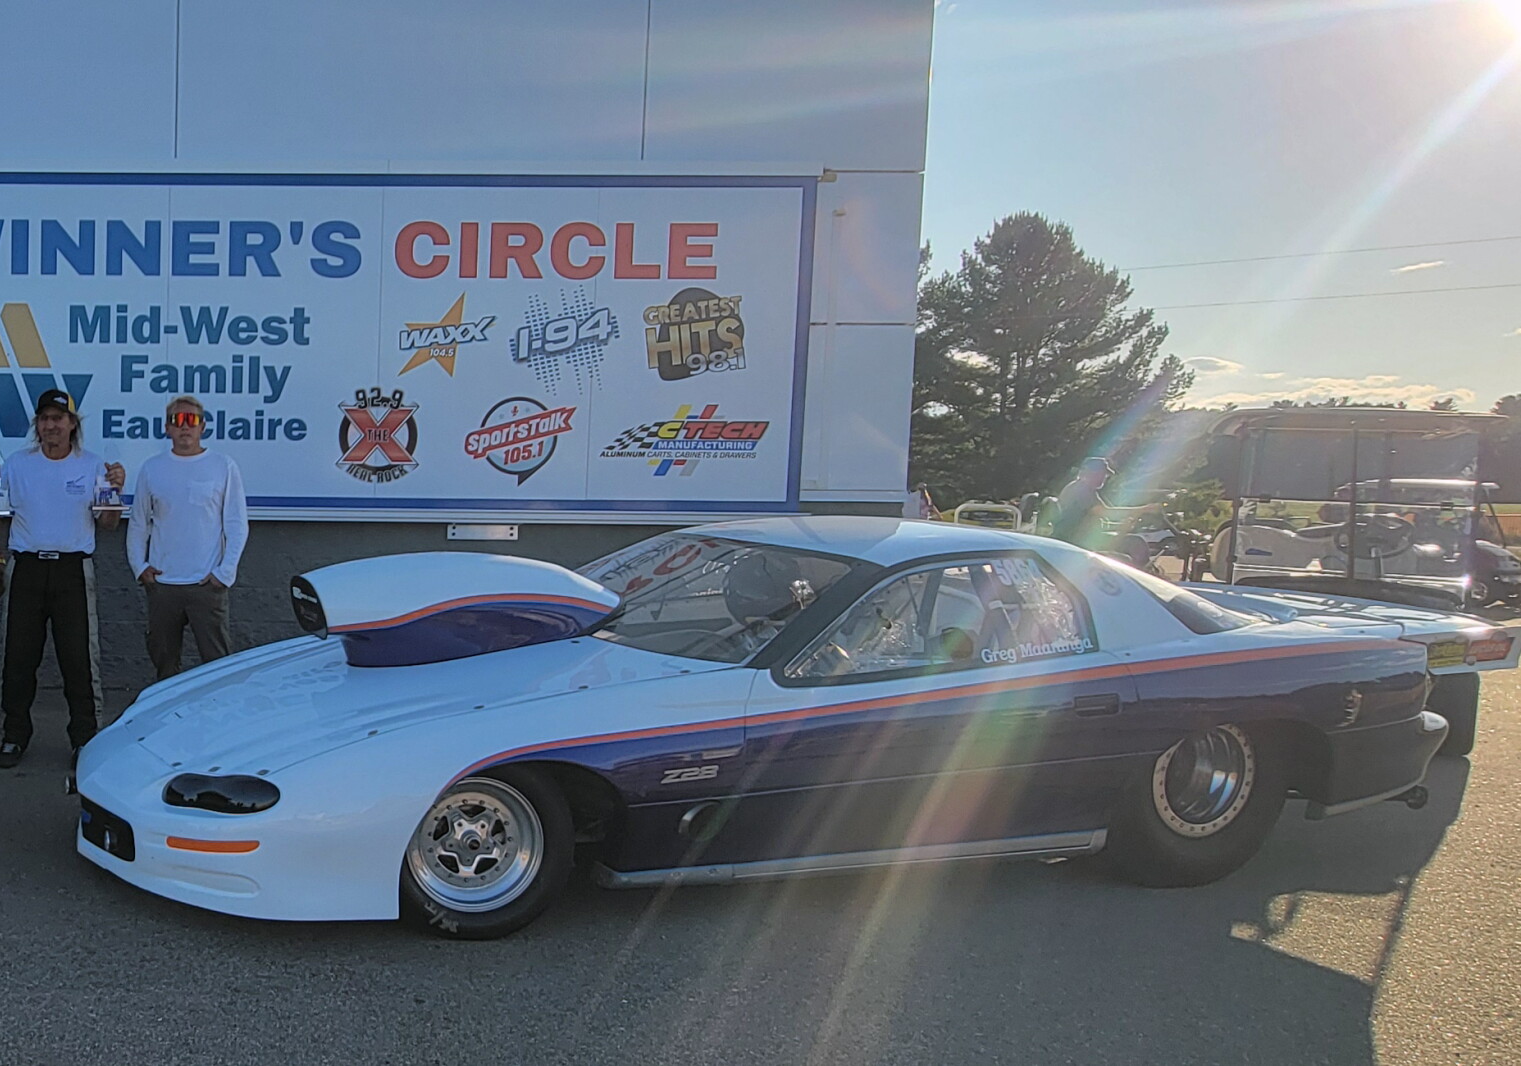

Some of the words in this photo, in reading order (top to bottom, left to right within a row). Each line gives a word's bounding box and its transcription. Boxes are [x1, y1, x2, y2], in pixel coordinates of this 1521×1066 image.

[394, 221, 719, 280] CIRCLE
[643, 295, 742, 325] GREATEST
[68, 304, 311, 345] Mid-West
[399, 315, 497, 350] WAXX
[430, 348, 455, 357] 104.5
[645, 317, 742, 370] HITS
[685, 347, 746, 375] 98.1
[120, 354, 292, 402] Family
[355, 387, 404, 409] 92.9
[368, 429, 388, 441] THE
[658, 440, 752, 450] MANUFACTURING
[503, 441, 545, 466] 105.1
[675, 451, 711, 459] CABINETS
[376, 465, 408, 483] ROCK
[981, 647, 1017, 663] Greg
[660, 765, 719, 784] Z28
